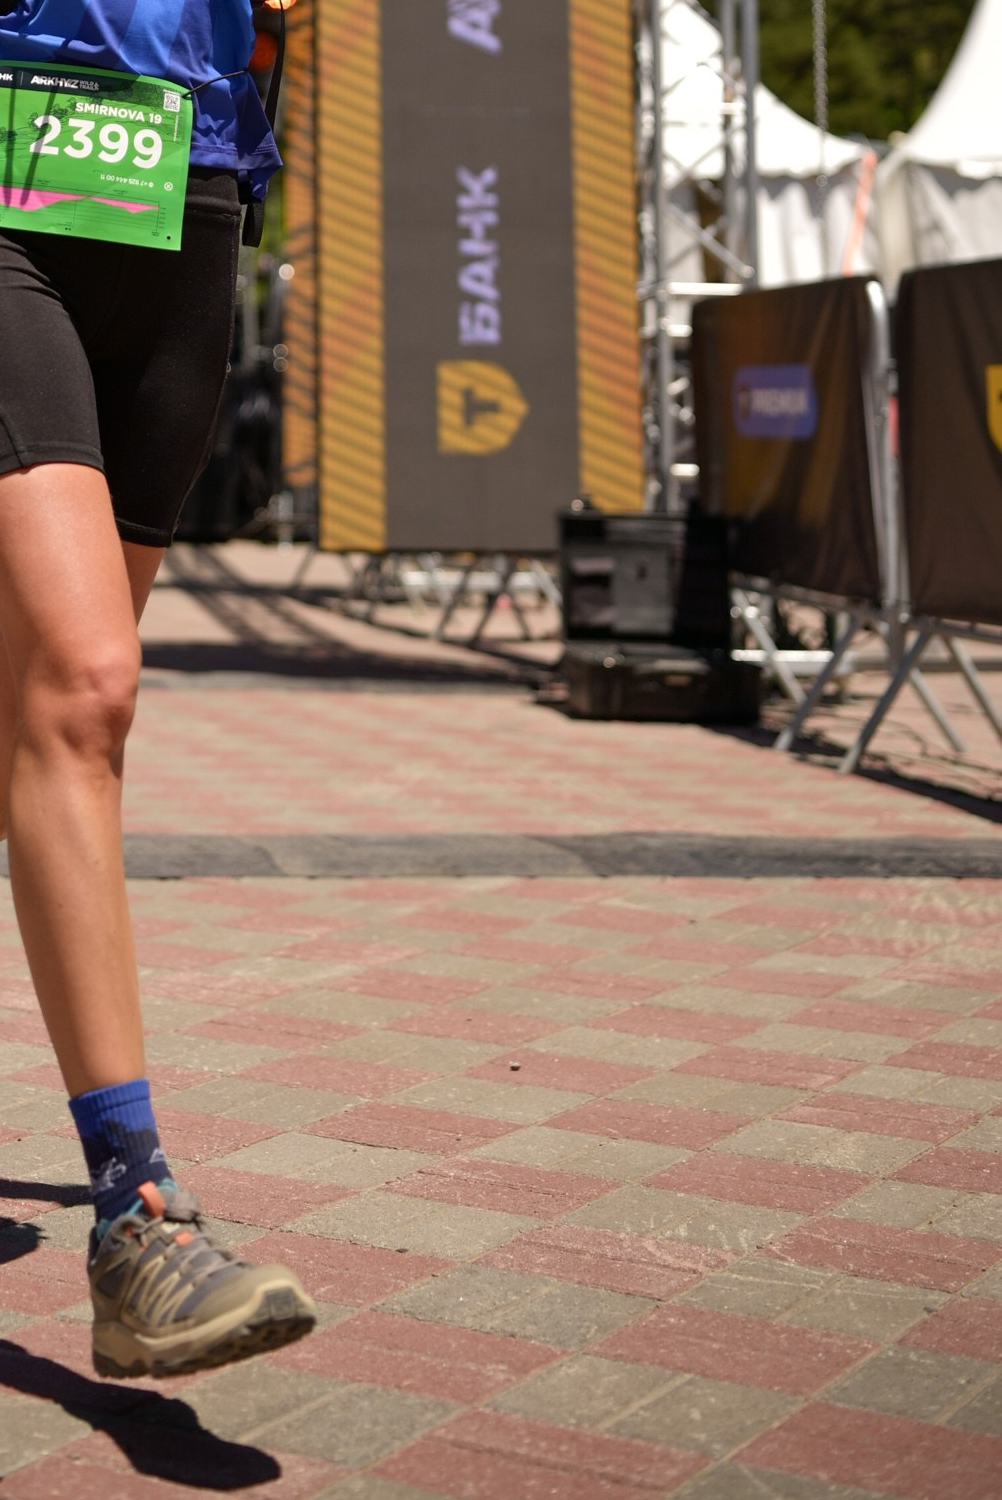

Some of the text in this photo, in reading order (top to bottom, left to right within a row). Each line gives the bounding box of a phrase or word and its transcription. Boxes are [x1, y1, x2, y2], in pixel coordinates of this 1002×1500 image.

[30, 75, 79, 89] ARKHYZ
[75, 102, 162, 125] SMIRNOVA 19
[29, 114, 163, 169] 2399
[456, 164, 501, 347] БАНК
